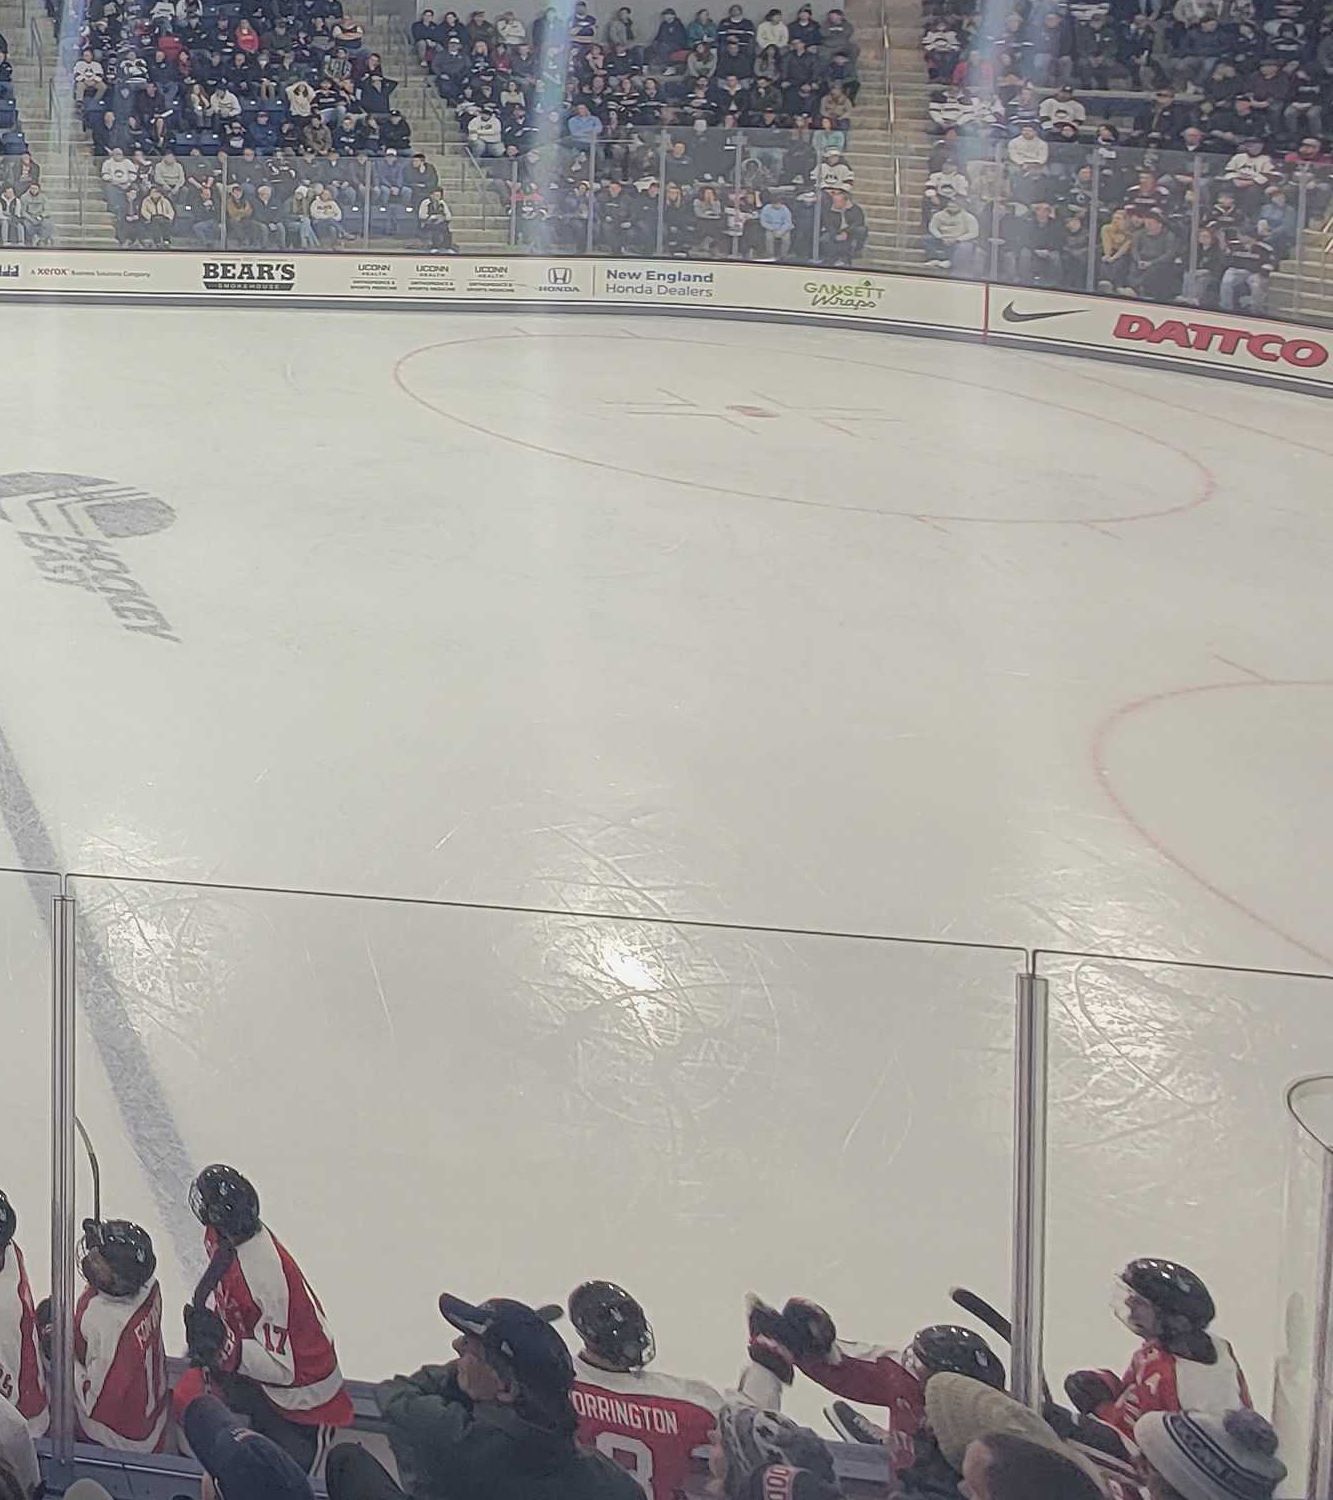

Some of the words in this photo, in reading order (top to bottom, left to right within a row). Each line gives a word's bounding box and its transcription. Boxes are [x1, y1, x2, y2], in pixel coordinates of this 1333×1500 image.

[37, 267, 69, 277] xerox
[202, 262, 296, 281] BEAR'S
[358, 264, 391, 272] UCONN
[475, 266, 508, 274] UCONN
[606, 269, 642, 280] New
[645, 271, 713, 284] England
[606, 283, 653, 295] Honda
[656, 285, 713, 297] Dealers
[803, 282, 885, 299] GANSETT
[811, 290, 877, 310] Wraps
[1113, 313, 1329, 368] DATTCO
[569, 1389, 679, 1436] ORRINGTON
